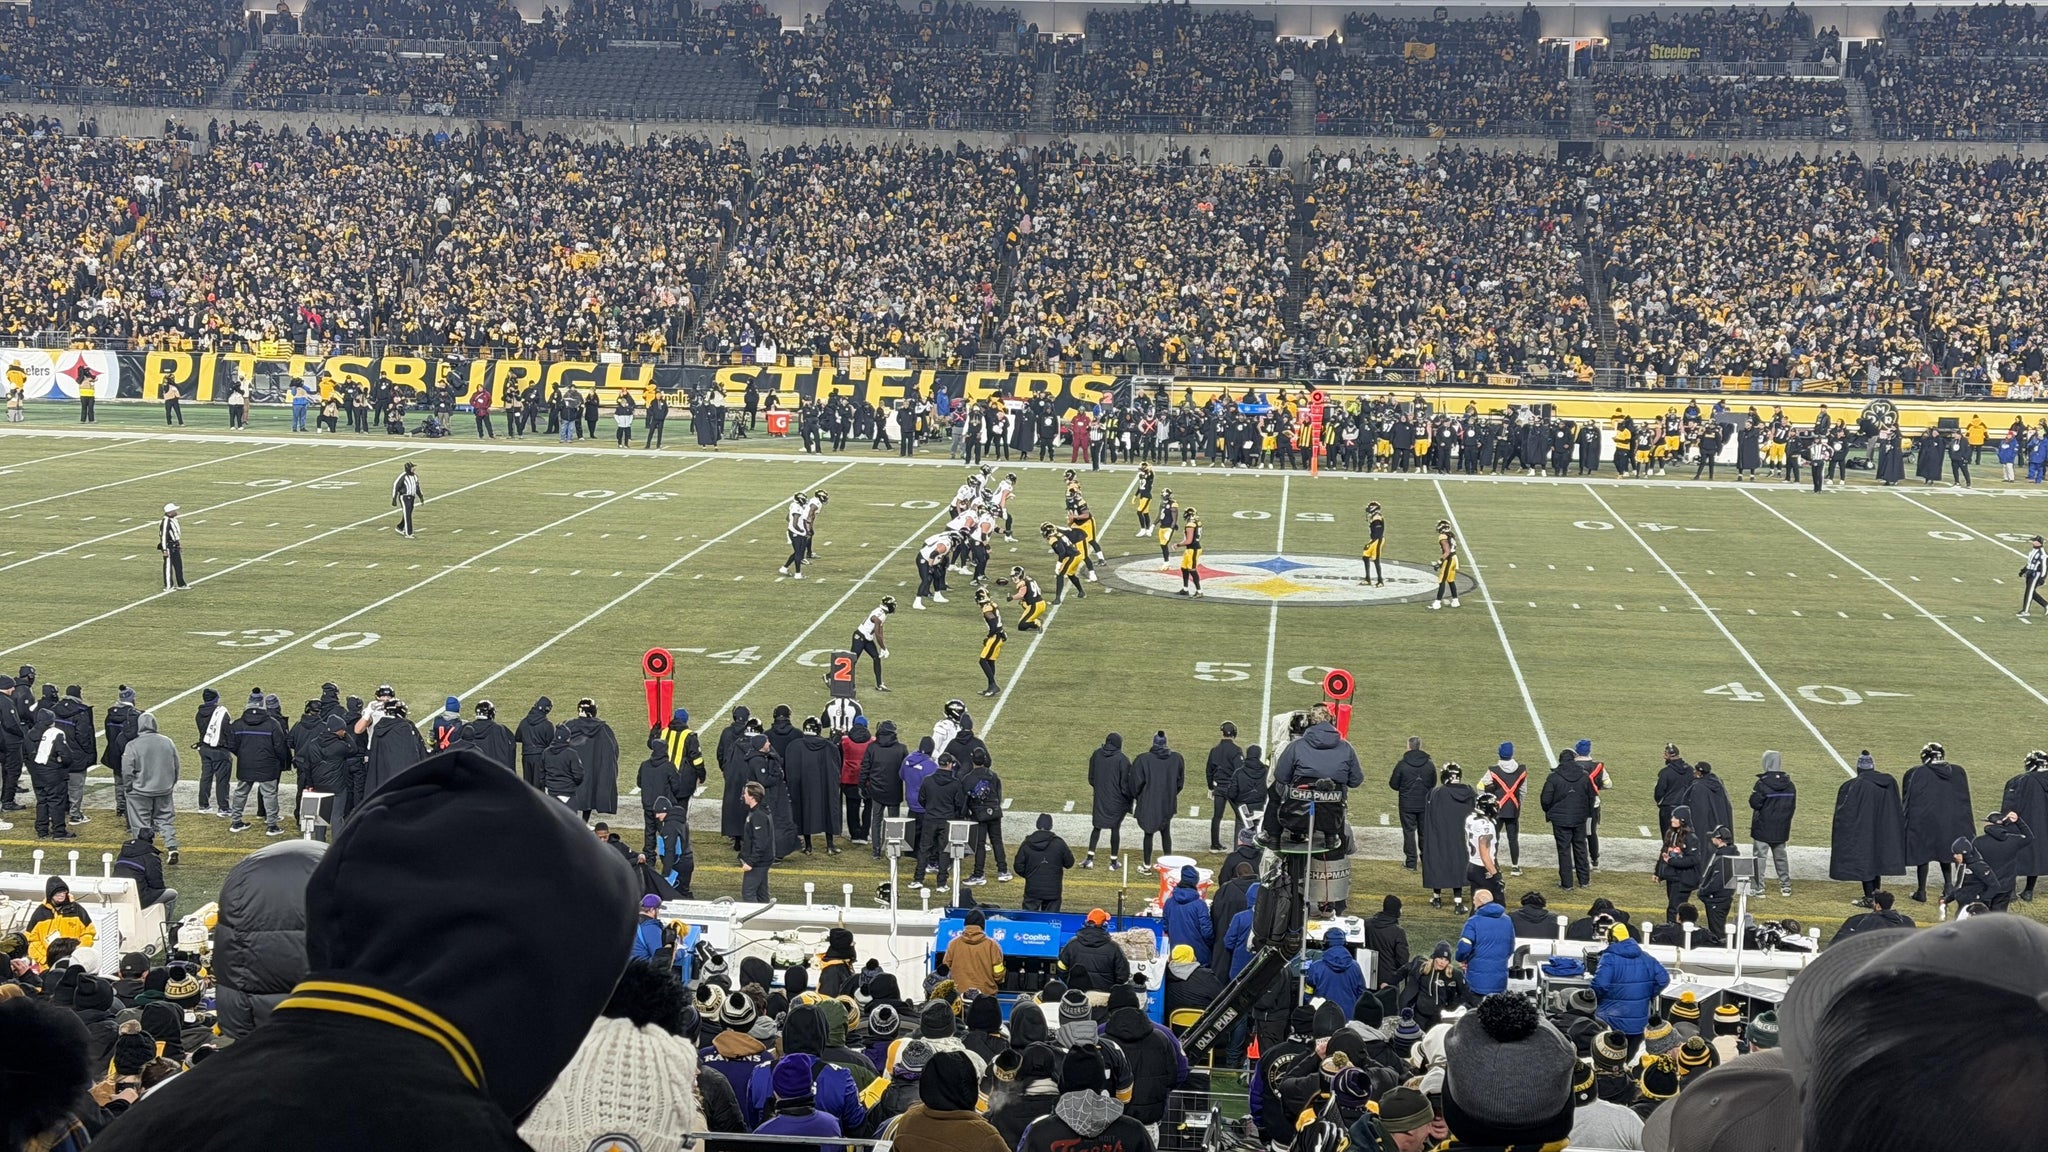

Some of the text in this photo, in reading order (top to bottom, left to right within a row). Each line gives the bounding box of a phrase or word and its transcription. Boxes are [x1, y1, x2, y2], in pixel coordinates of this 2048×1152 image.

[1650, 43, 1701, 60] Steelers
[26, 365, 50, 376] elers
[776, 417, 787, 428] G
[1382, 422, 1392, 433] 97
[1669, 421, 1678, 431] 54
[217, 629, 381, 650] 30
[834, 657, 852, 681] 2
[1193, 662, 1335, 685] 50
[1703, 682, 1864, 706] 40
[1292, 789, 1341, 801] CHAPMAN
[1307, 868, 1350, 880] CHAPMAN
[1022, 933, 1051, 941] Copilot
[704, 1053, 762, 1063] RAENS
